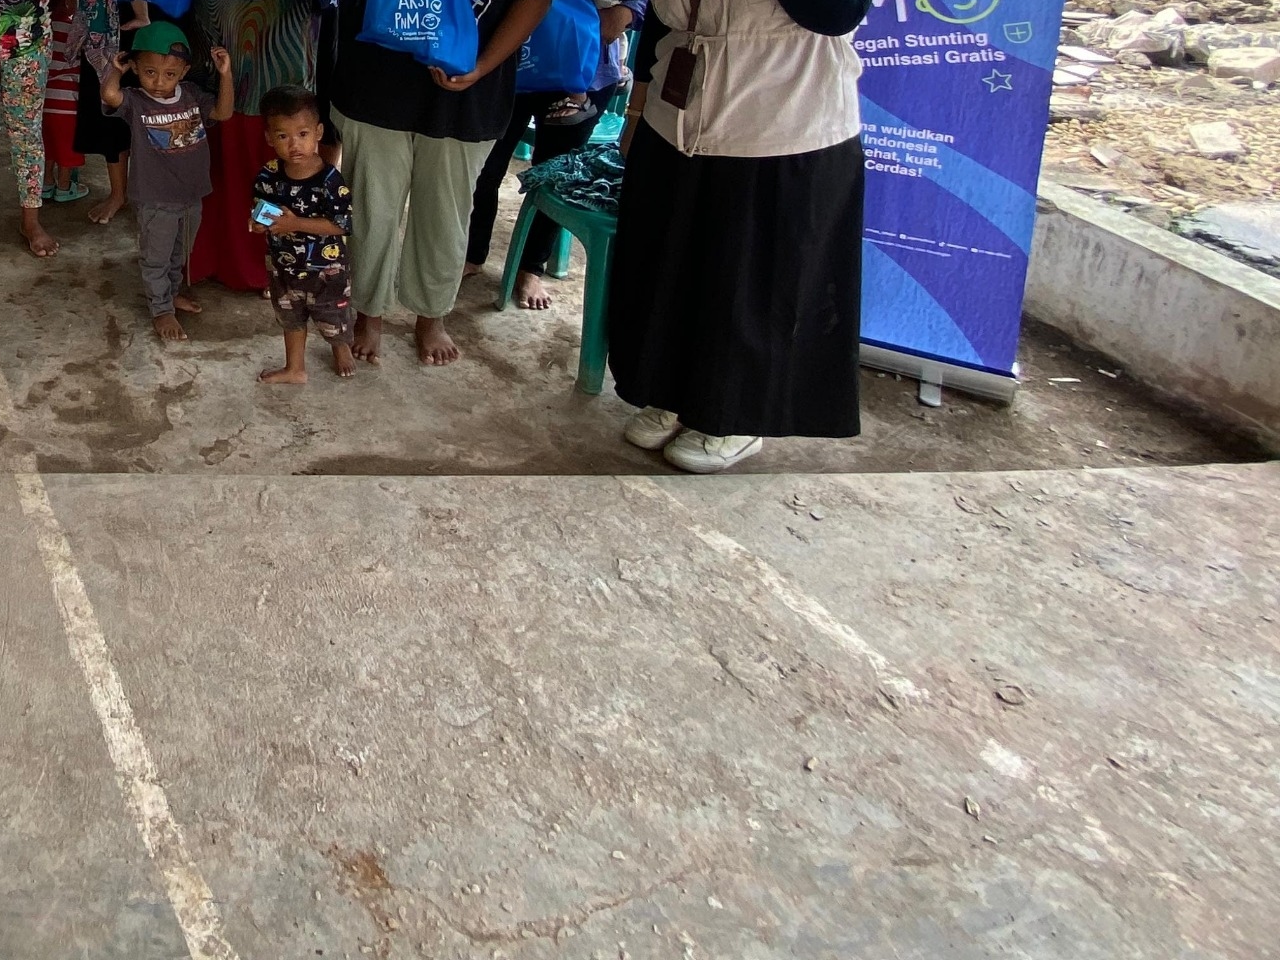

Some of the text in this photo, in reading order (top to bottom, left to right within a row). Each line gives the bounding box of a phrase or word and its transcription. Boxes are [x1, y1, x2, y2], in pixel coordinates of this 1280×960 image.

[851, 32, 988, 52] egah Stunting
[944, 49, 1006, 64] Gratis
[863, 134, 938, 154] Indonesia
[880, 125, 955, 144] wujudkan
[862, 148, 942, 169] ehat, kuat,
[864, 160, 923, 178] Cerdas!
